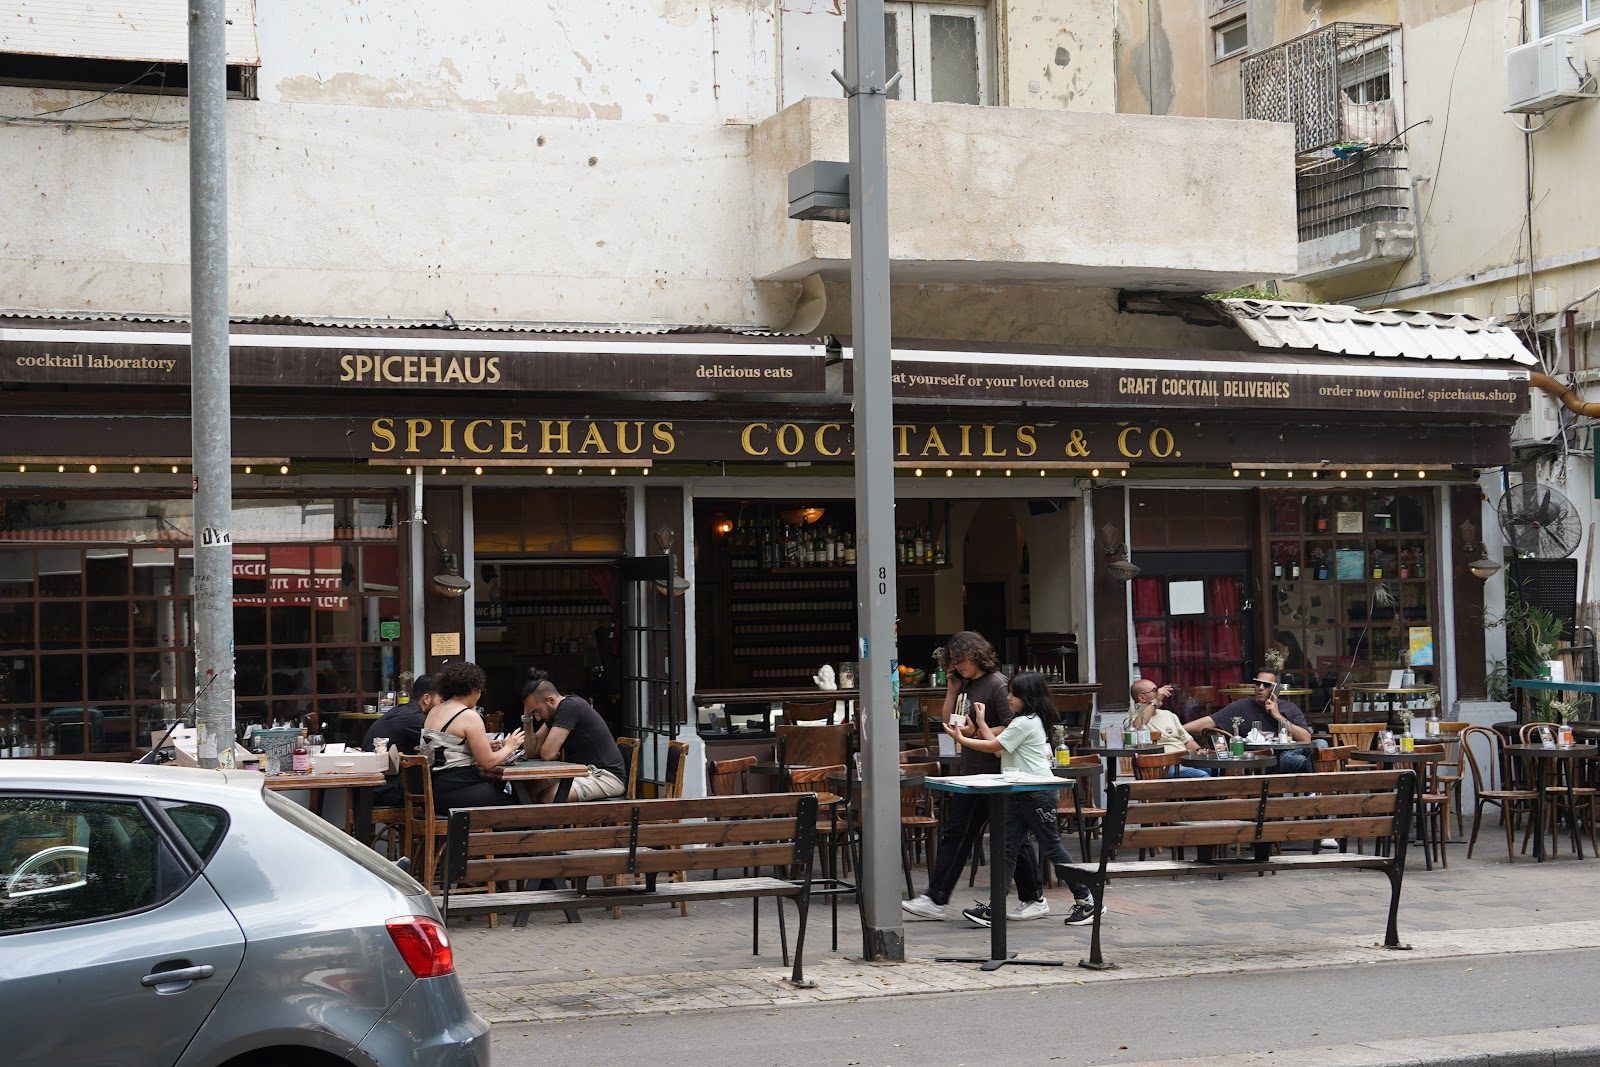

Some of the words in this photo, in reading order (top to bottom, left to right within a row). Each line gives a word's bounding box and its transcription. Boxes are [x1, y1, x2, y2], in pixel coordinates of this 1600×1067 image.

[16, 353, 84, 368] cocktail
[87, 354, 177, 372] laboratory
[340, 354, 501, 384] SPICEHAUS
[695, 364, 762, 379] delicious
[763, 366, 794, 379] eats
[909, 373, 967, 387] yourself
[967, 377, 984, 387] or
[985, 377, 1018, 390] your
[1019, 374, 1056, 388] loved
[1057, 378, 1089, 389] ones
[1118, 376, 1158, 395] CRAFT
[1161, 378, 1219, 398] COCKTAIL
[1223, 380, 1291, 399] DELIVERIES
[1318, 384, 1354, 397] order
[1355, 388, 1382, 398] now
[1383, 386, 1425, 399] online!
[1427, 388, 1517, 404] spicehaus.shop
[371, 417, 677, 455] SPICEHAUS
[741, 422, 1037, 457] COCTAILS
[1065, 429, 1091, 457] &
[1117, 427, 1182, 458] CO.
